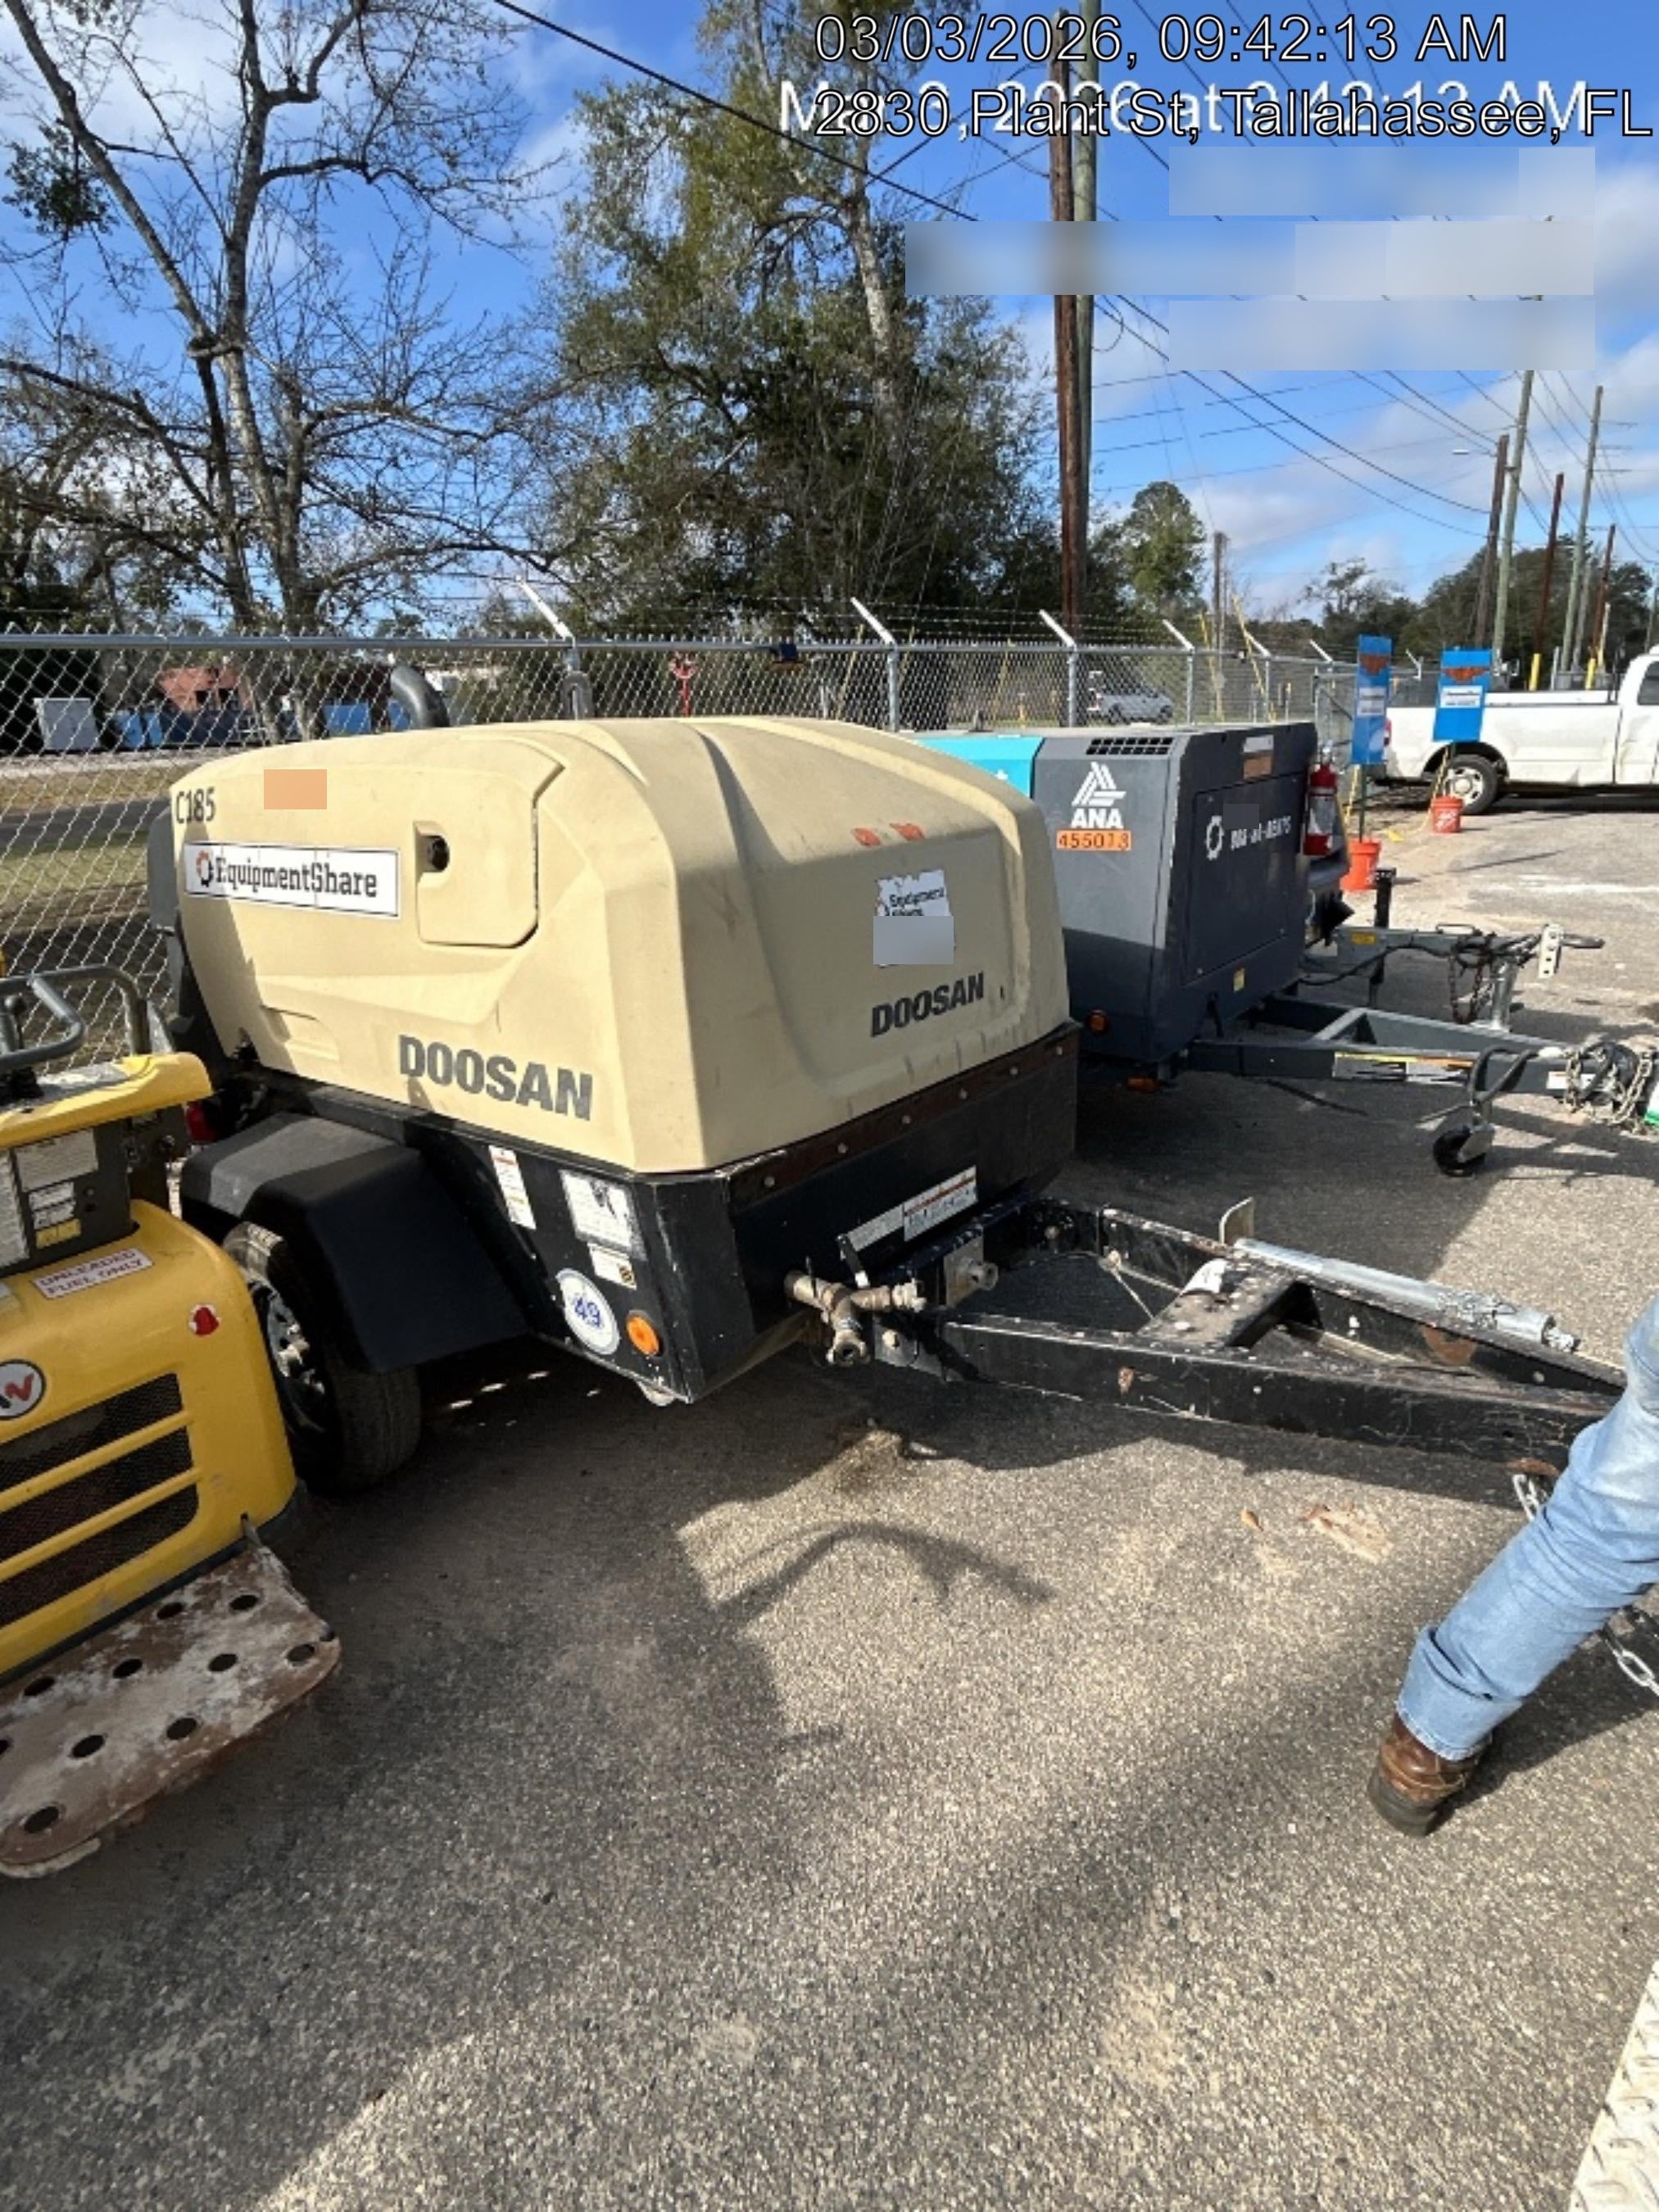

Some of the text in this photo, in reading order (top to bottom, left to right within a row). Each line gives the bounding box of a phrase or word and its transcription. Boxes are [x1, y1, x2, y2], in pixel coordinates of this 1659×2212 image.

[175, 786, 217, 824] C185
[1070, 808, 1124, 829] ANA
[215, 857, 378, 898] EquipmentShare
[871, 970, 985, 1038] DOOSAN
[397, 1033, 594, 1122] DOOSAN
